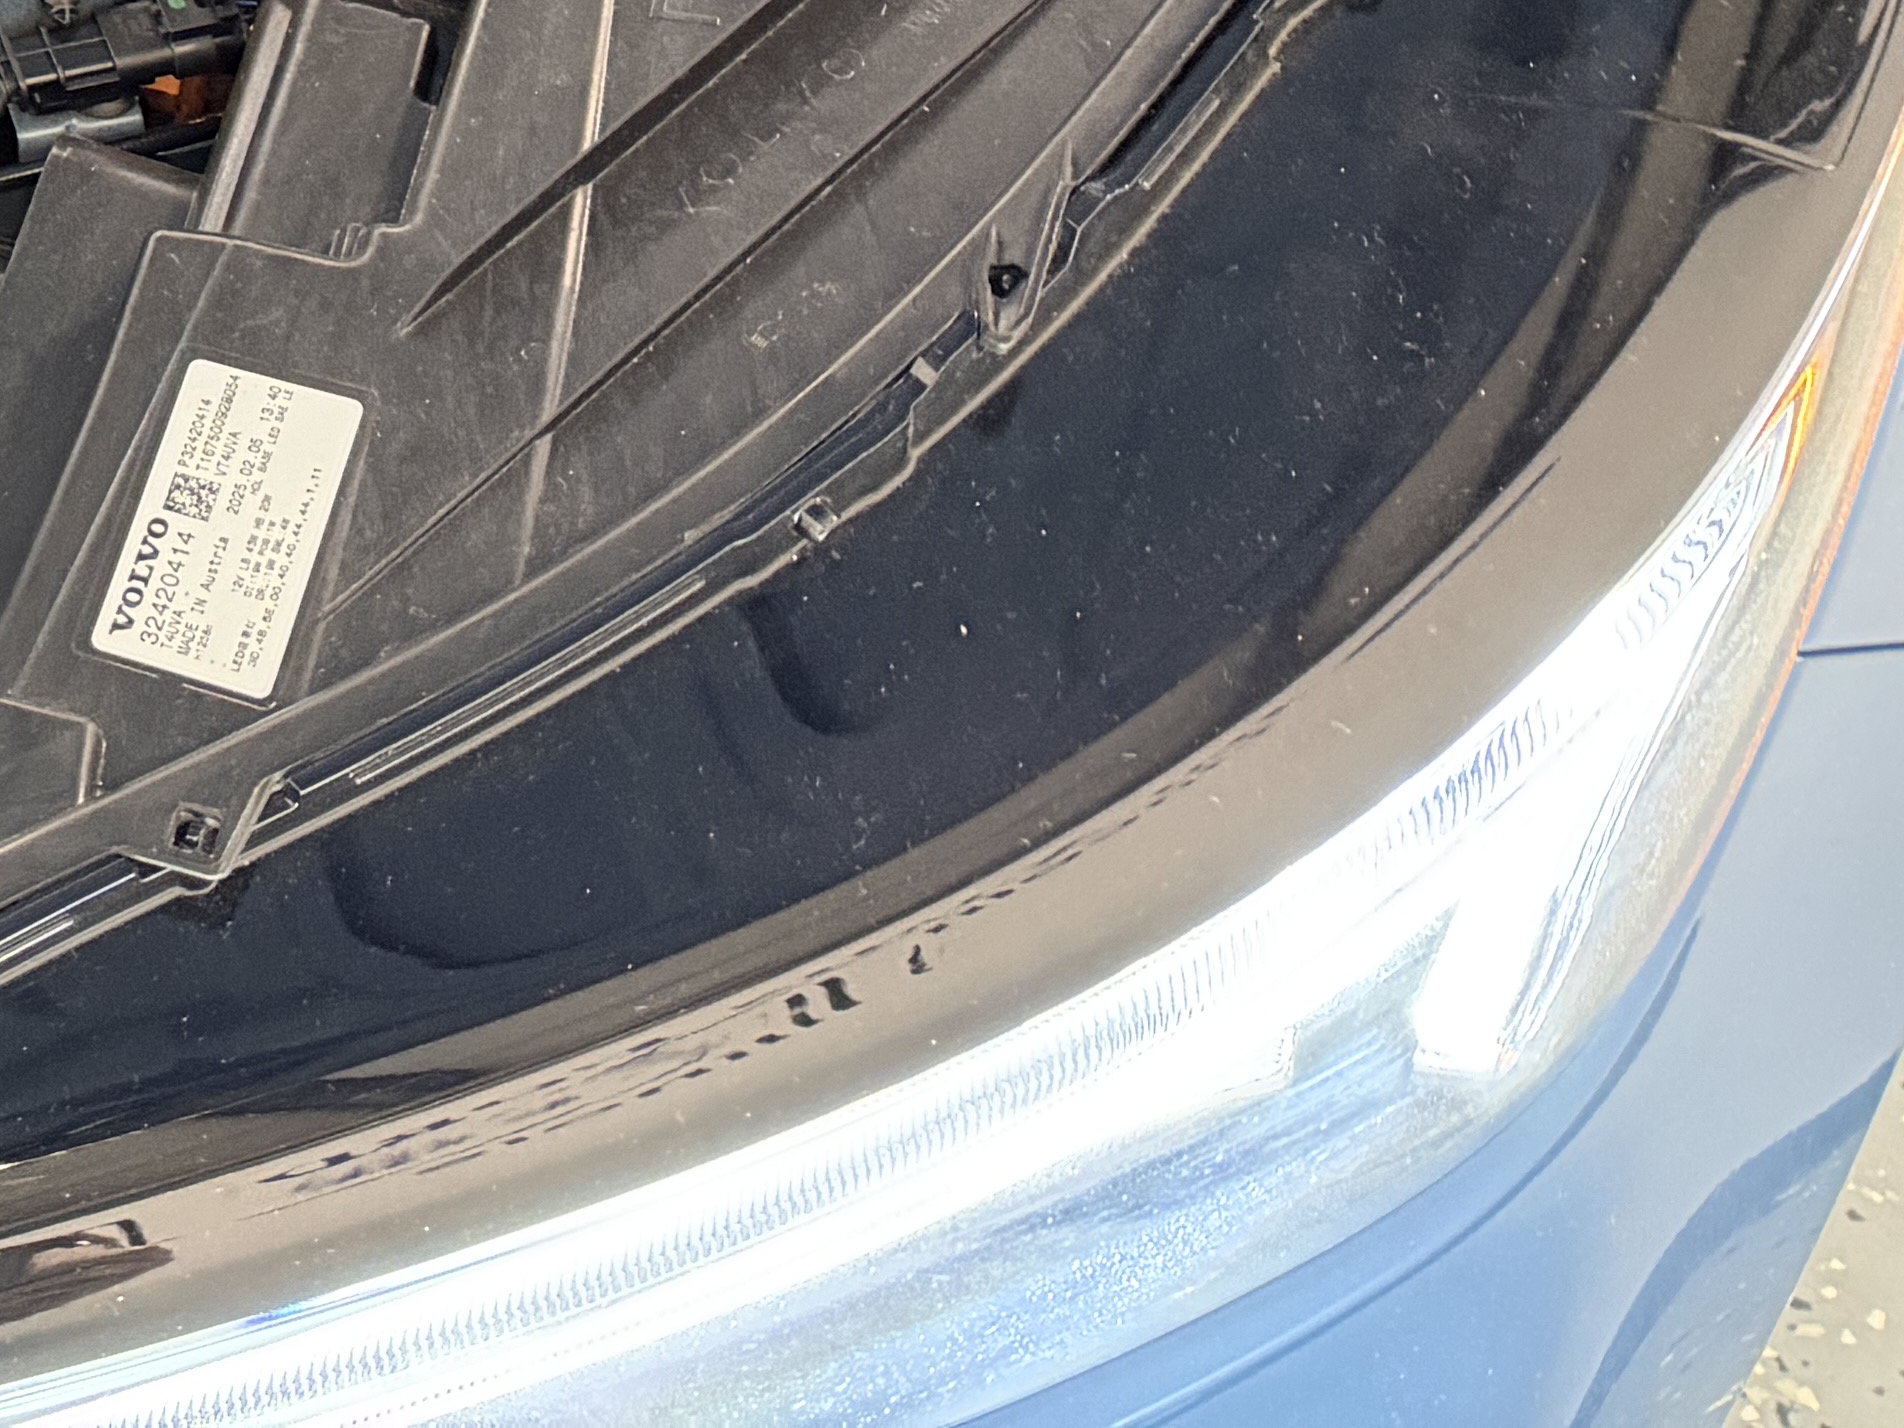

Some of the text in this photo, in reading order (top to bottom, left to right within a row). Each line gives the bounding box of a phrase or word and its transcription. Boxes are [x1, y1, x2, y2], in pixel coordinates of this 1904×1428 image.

[175, 397, 213, 469] P32420414
[212, 430, 242, 477] VT4UVA
[224, 384, 282, 516] 2025.02.05 13:40
[266, 425, 281, 446] LED
[106, 515, 170, 636] VOLVO
[138, 530, 196, 646] 32420414
[175, 535, 230, 657] MADE IN Austria
[158, 609, 187, 649] T4UVA
